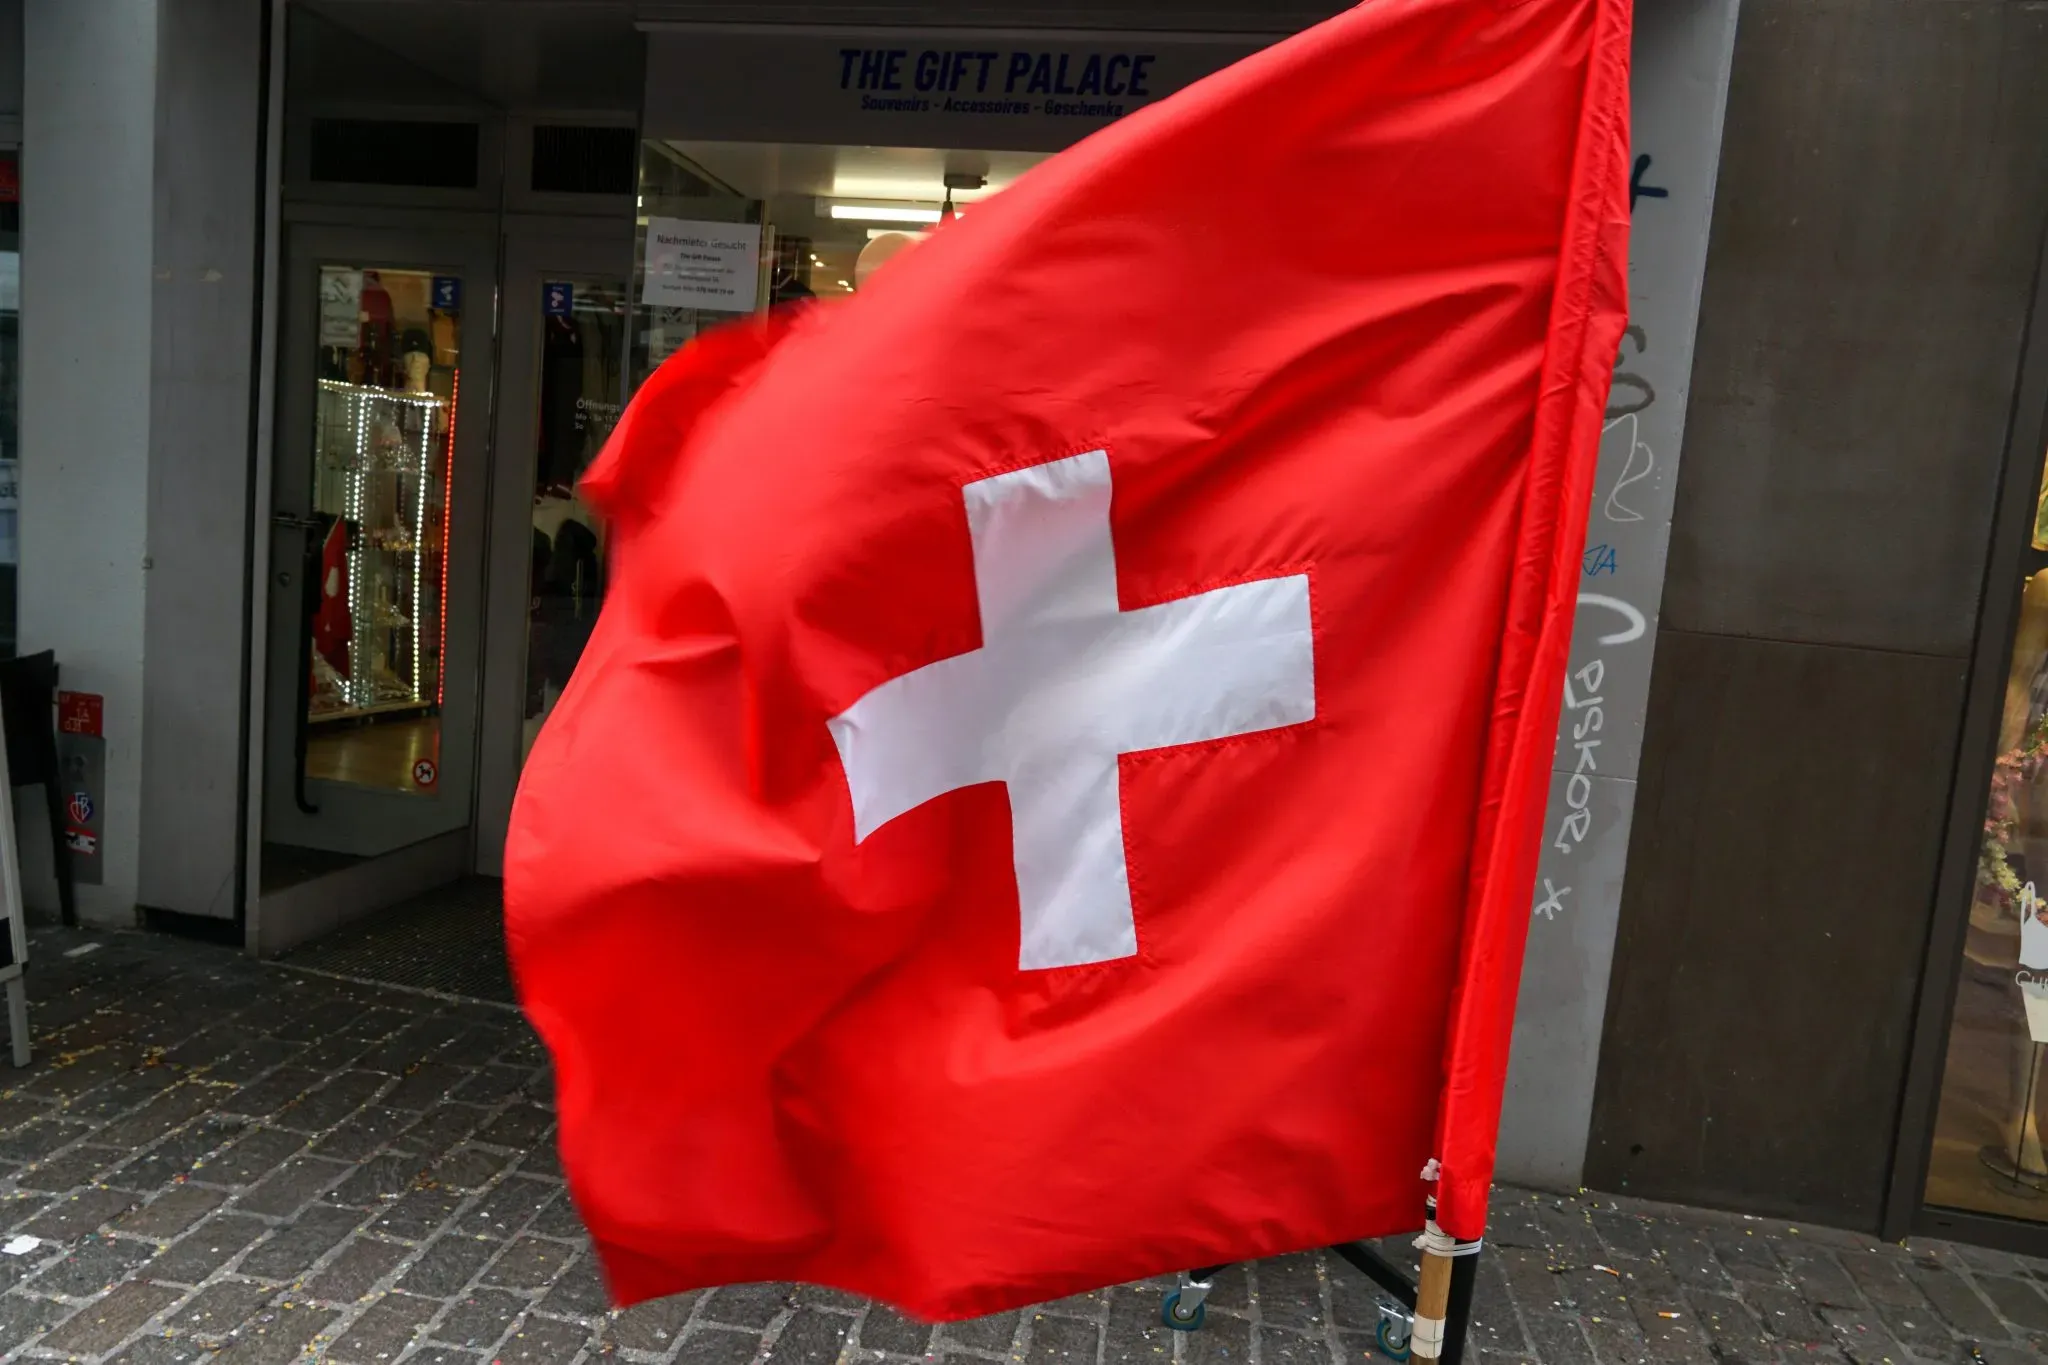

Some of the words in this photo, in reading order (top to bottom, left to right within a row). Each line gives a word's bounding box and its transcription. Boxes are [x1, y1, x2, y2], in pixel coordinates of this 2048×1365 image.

[839, 49, 906, 91] THE
[914, 51, 998, 93] GIFT
[1004, 52, 1155, 97] PALACE
[861, 94, 929, 112] Souvenirs
[943, 97, 1029, 115] Accessoires
[576, 397, 620, 413] Öffnungs
